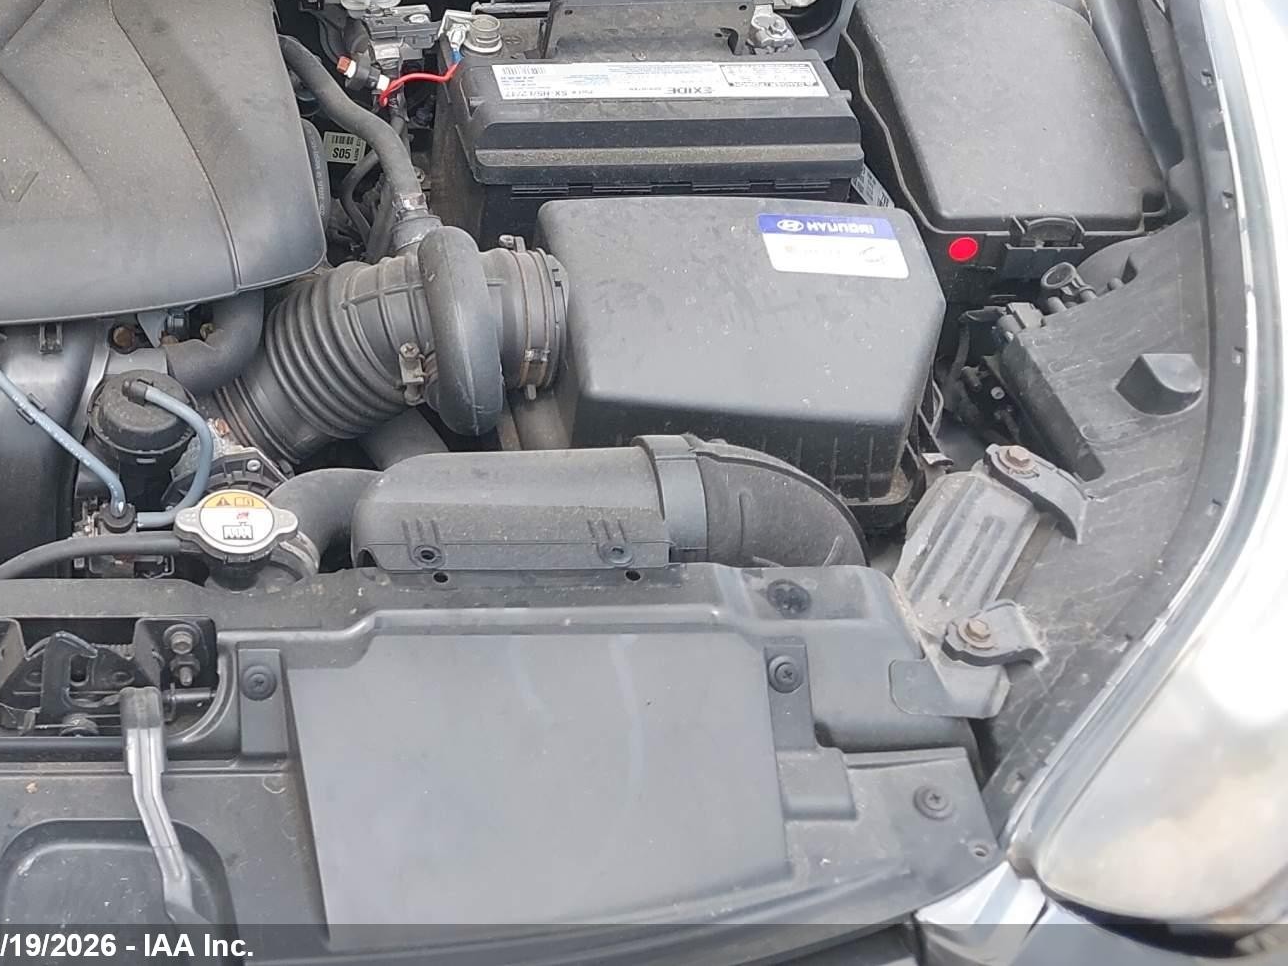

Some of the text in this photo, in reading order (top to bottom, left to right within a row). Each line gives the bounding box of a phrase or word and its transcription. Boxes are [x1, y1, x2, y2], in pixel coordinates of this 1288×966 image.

[664, 86, 715, 95] EXIDE
[332, 147, 352, 159] S05
[806, 221, 875, 235] HYUNDAI
